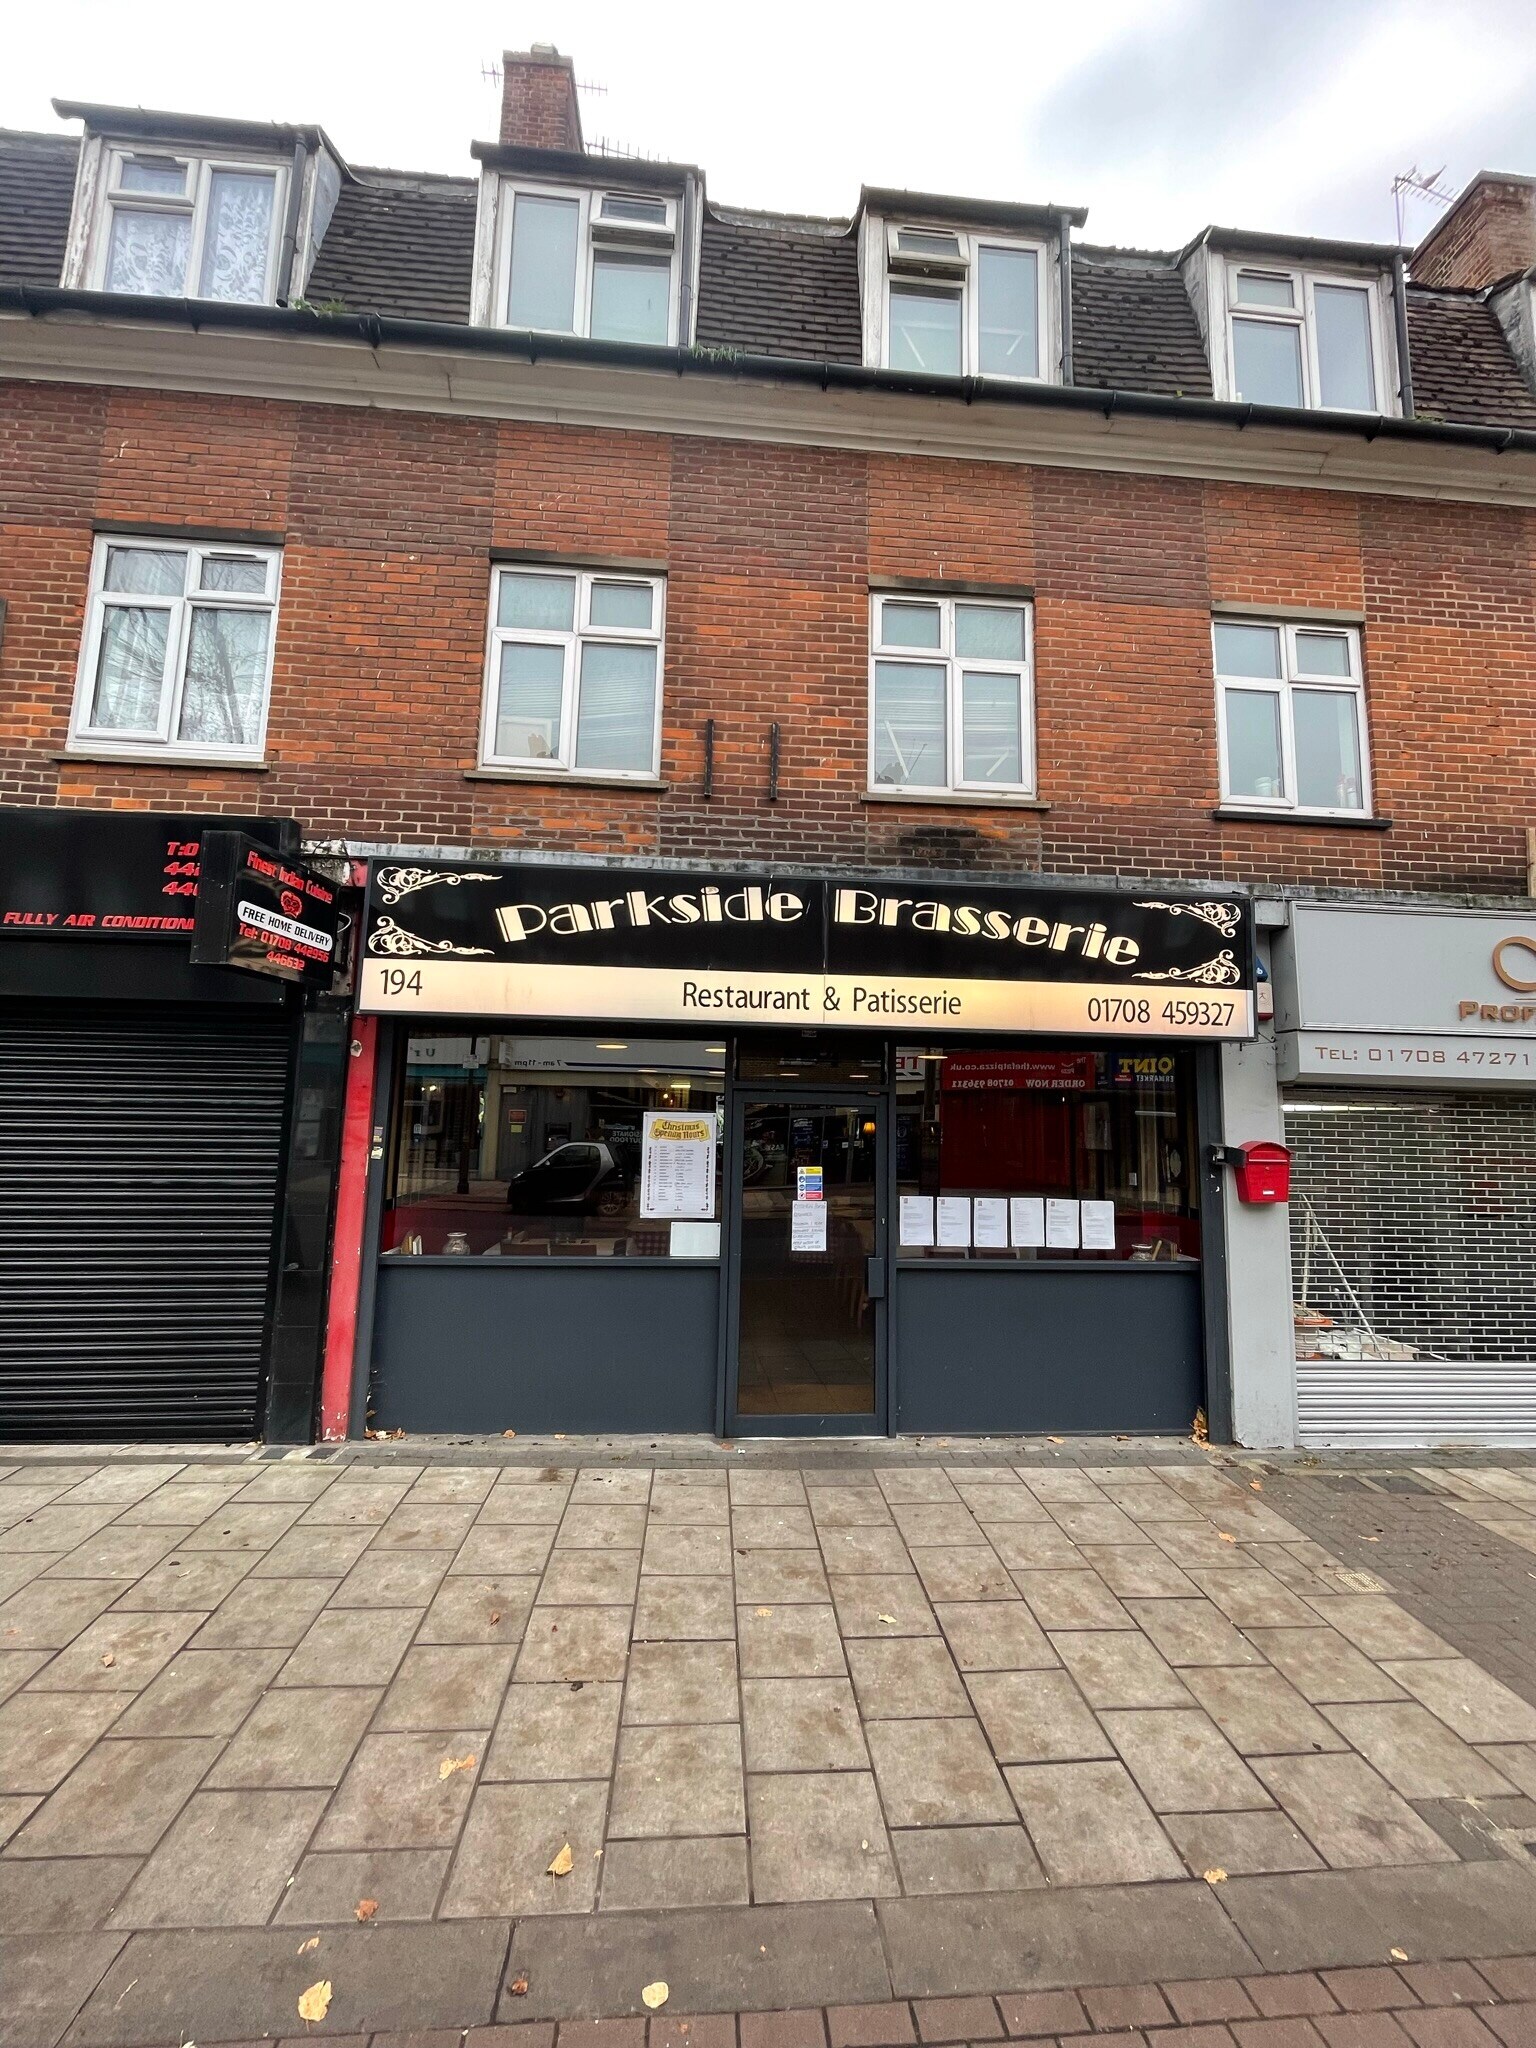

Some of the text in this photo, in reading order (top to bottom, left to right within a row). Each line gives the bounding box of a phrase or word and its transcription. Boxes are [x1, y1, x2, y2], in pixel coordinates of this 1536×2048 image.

[246, 850, 333, 904] Finest Indian Cuisine
[3, 911, 59, 926] FULLY
[62, 914, 96, 927] AIR
[242, 906, 330, 946] FREE HOME DELIVERY
[495, 886, 1140, 966] Parkside Brasserie
[239, 922, 329, 963] Tel: 01708 442956
[380, 969, 1235, 1027] 194 Restaurant & Patisserie 01708 459327
[1369, 1048, 1446, 1064] 01708
[1457, 1051, 1529, 1066] 47271
[661, 1120, 700, 1131] Christmas
